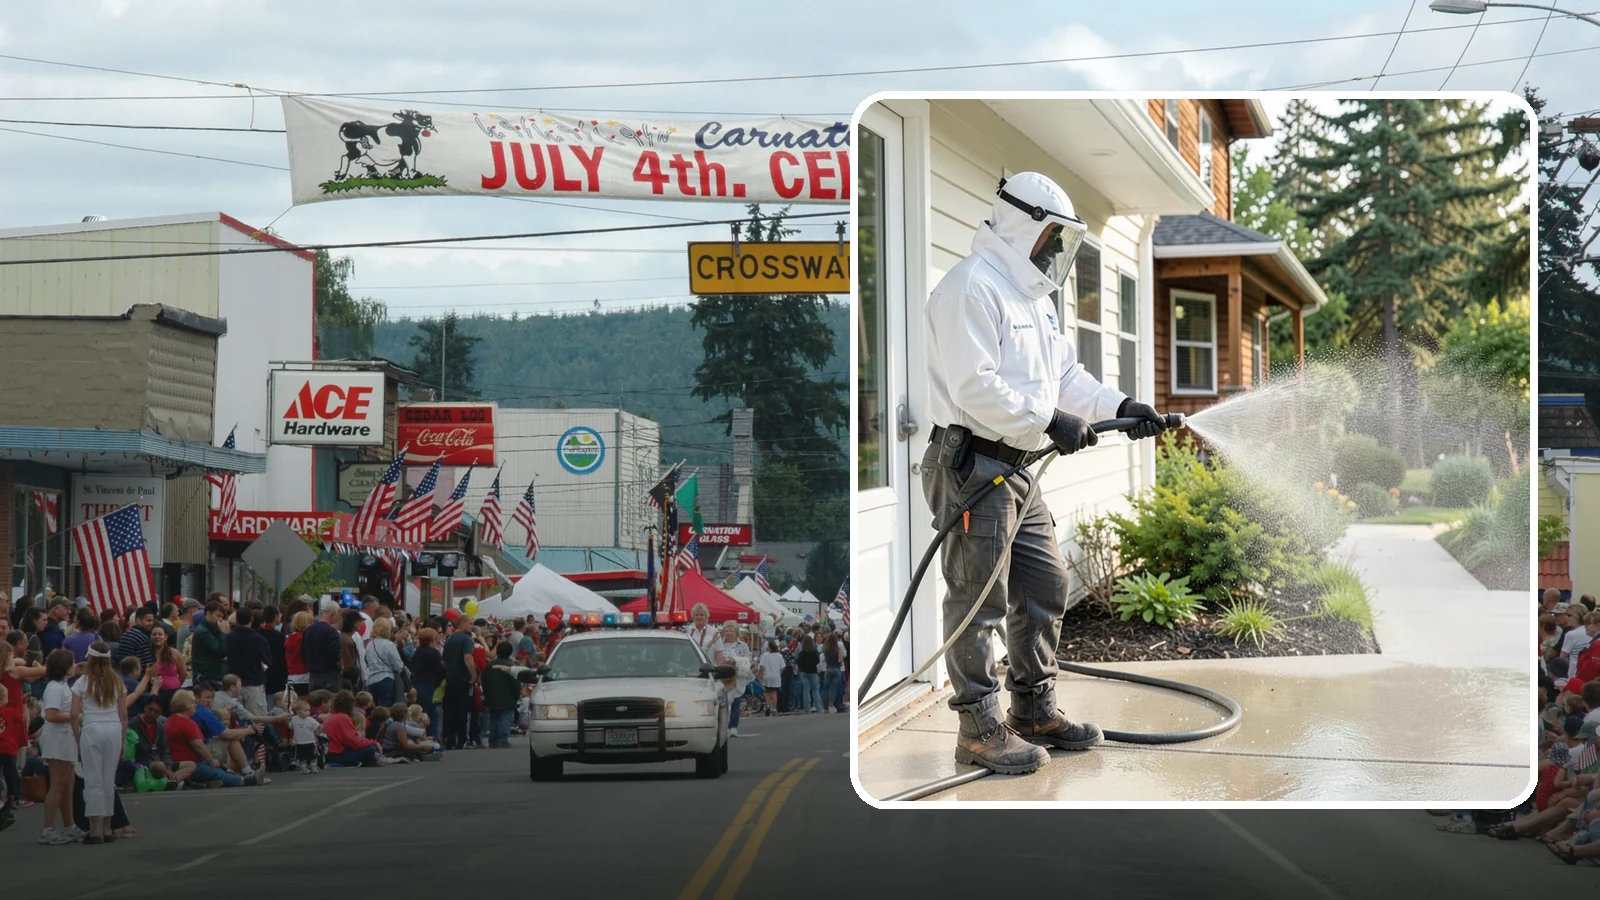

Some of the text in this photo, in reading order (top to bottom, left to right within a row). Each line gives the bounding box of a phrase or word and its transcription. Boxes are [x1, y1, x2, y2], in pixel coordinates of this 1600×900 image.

[481, 141, 604, 192] JULY
[632, 150, 746, 197] 4th.
[697, 254, 850, 280] CROSSWA
[282, 380, 373, 420] ACE
[405, 409, 485, 422] CEDAR LOG
[283, 421, 370, 436] Hardware
[416, 428, 476, 447] Coca-Cola
[353, 467, 388, 482] Simpl
[95, 485, 124, 494] Vincent
[126, 486, 136, 494] de
[137, 486, 155, 495] Paul
[212, 516, 330, 536] HARDARE
[688, 526, 742, 535] CRNATION
[699, 535, 731, 544] GLASS
